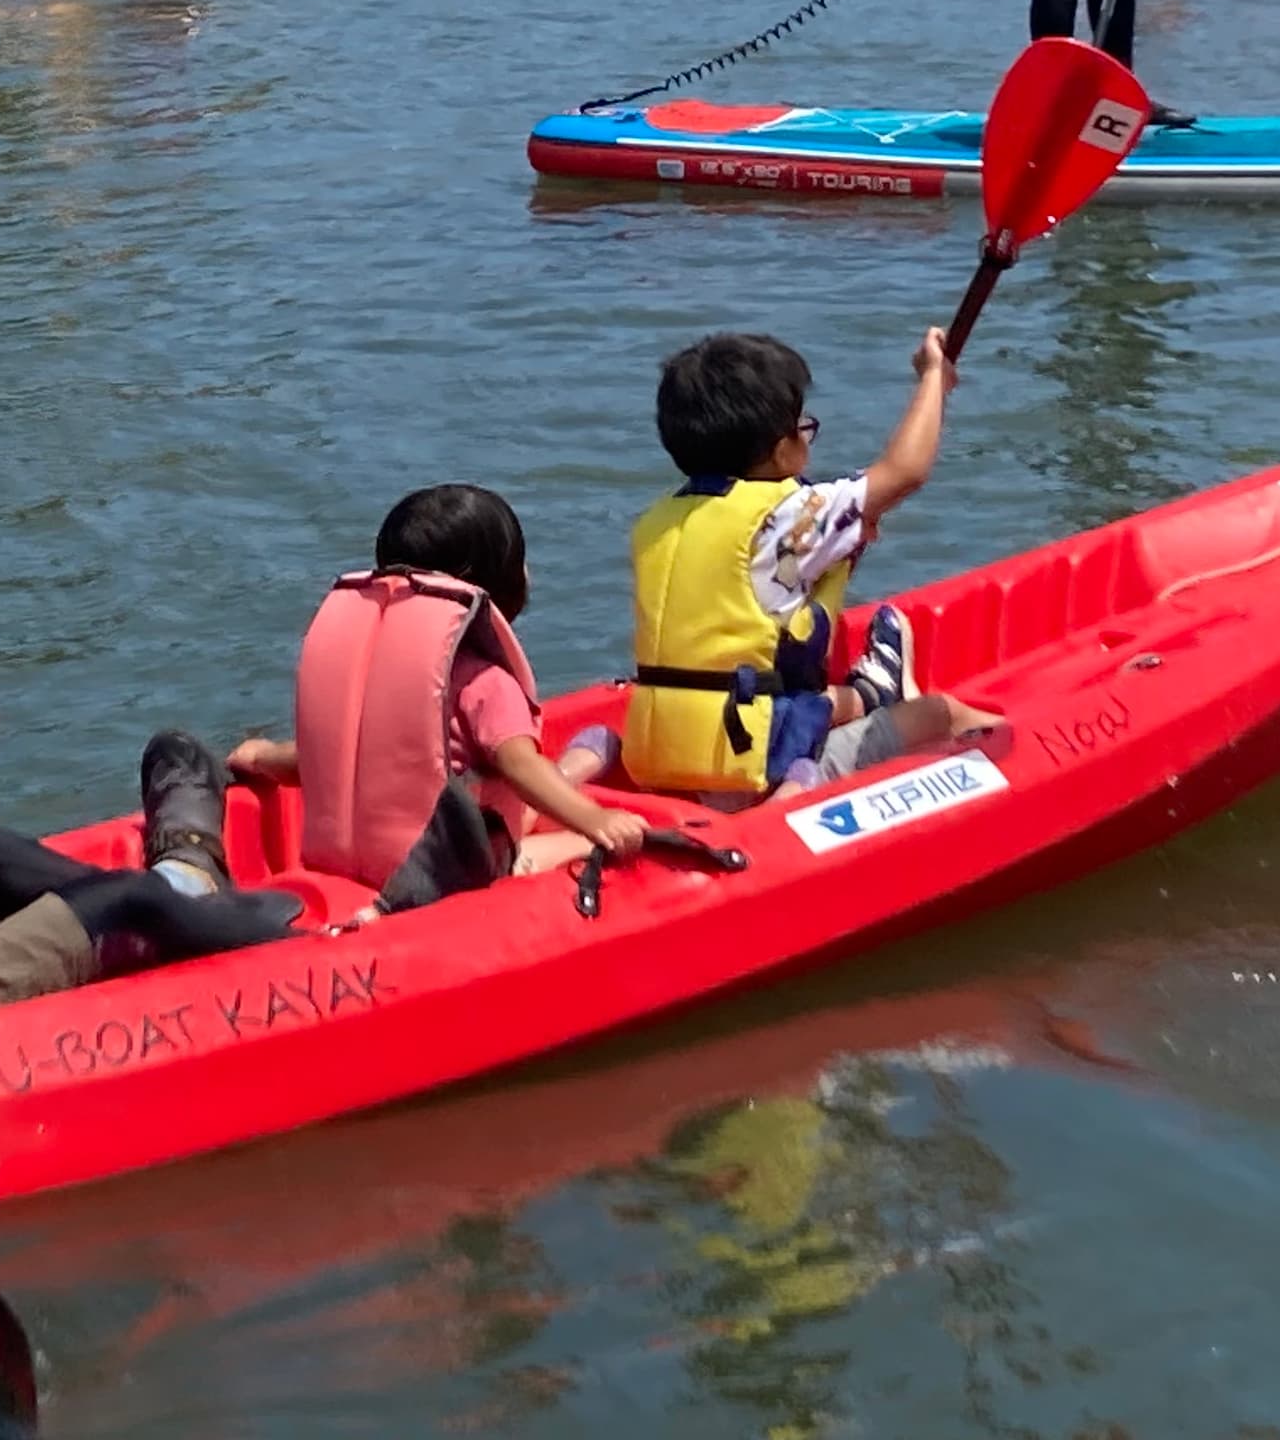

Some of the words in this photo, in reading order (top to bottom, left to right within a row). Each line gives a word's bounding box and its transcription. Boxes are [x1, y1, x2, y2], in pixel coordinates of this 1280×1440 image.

[1093, 115, 1130, 138] R
[806, 171, 912, 193] TOURING
[866, 763, 983, 821] 江戸川区
[214, 957, 398, 1038] KAYAK
